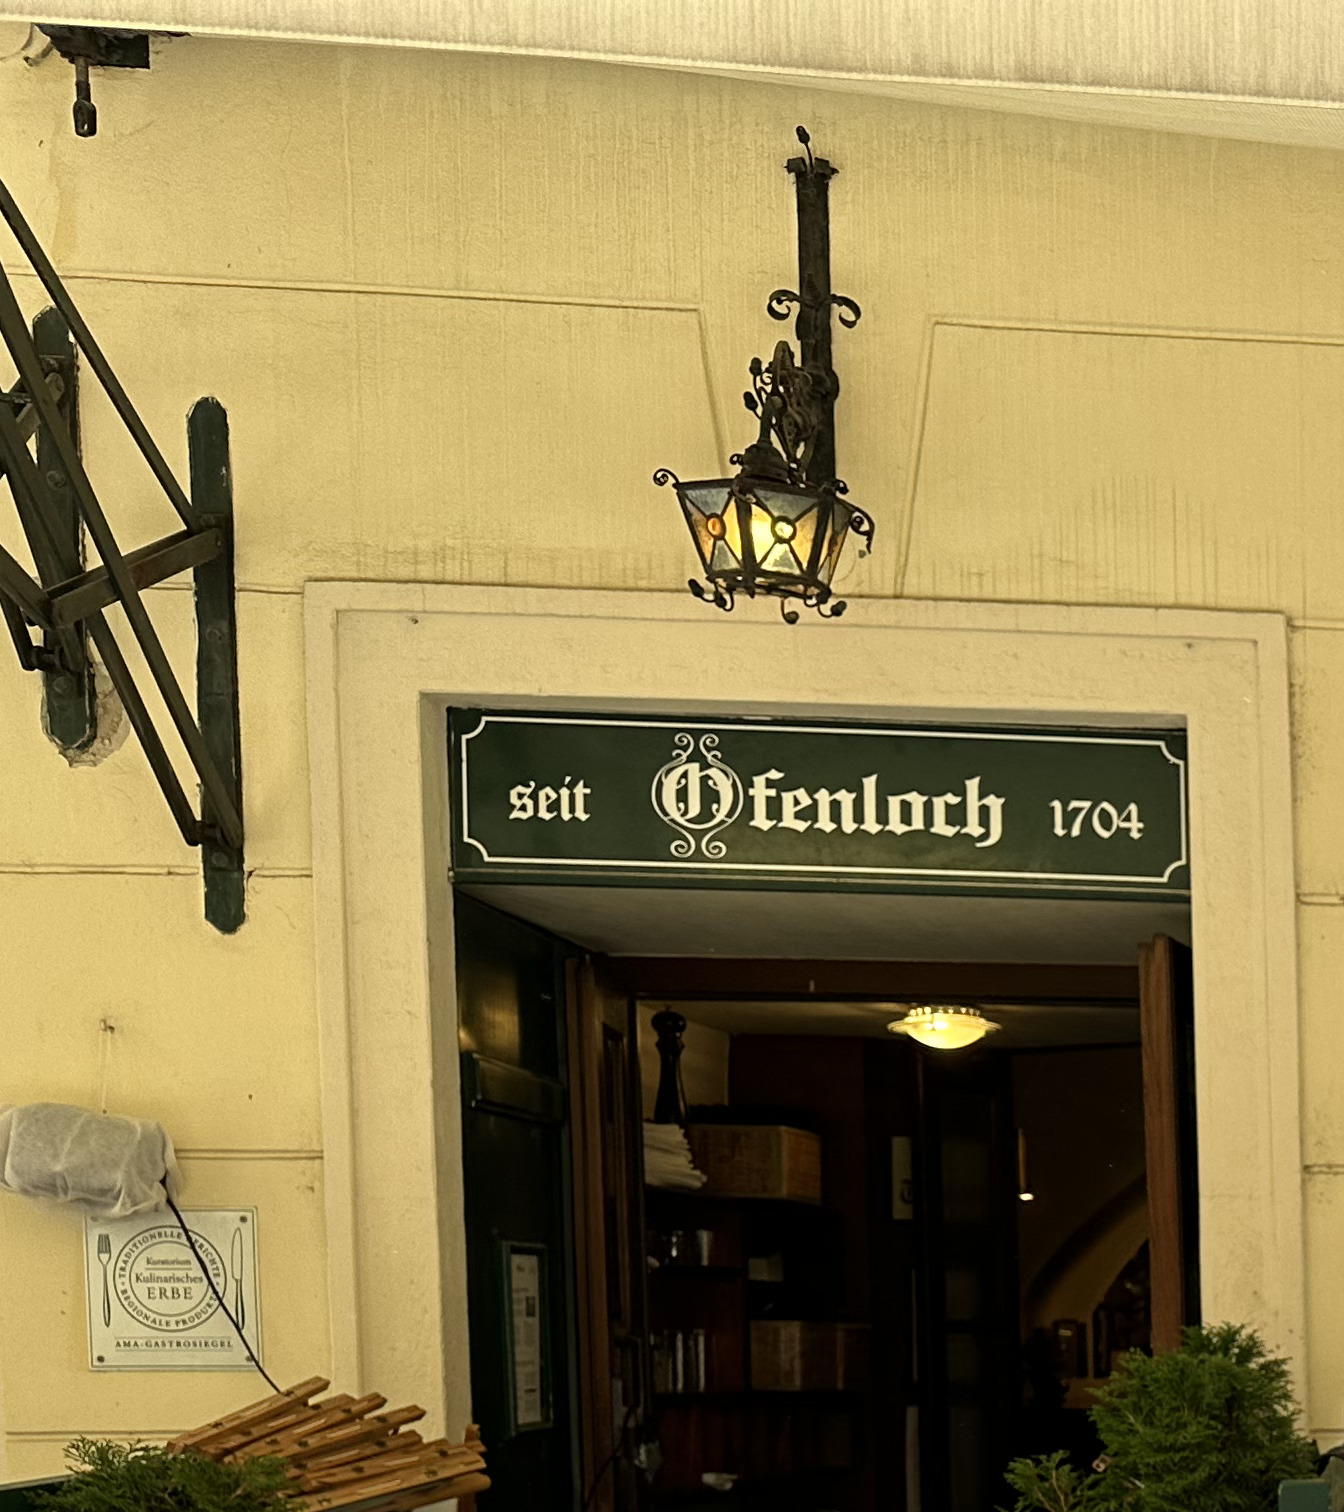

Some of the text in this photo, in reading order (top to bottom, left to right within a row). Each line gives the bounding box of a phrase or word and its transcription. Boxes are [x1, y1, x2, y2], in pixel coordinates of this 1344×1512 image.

[508, 756, 1145, 850] seit Ofenloch 1704
[118, 1230, 182, 1280] TRADITIONELLE
[135, 1271, 203, 1285] Kulinarisches
[146, 1286, 193, 1300] ERBE
[174, 1292, 220, 1328] PRODUKT
